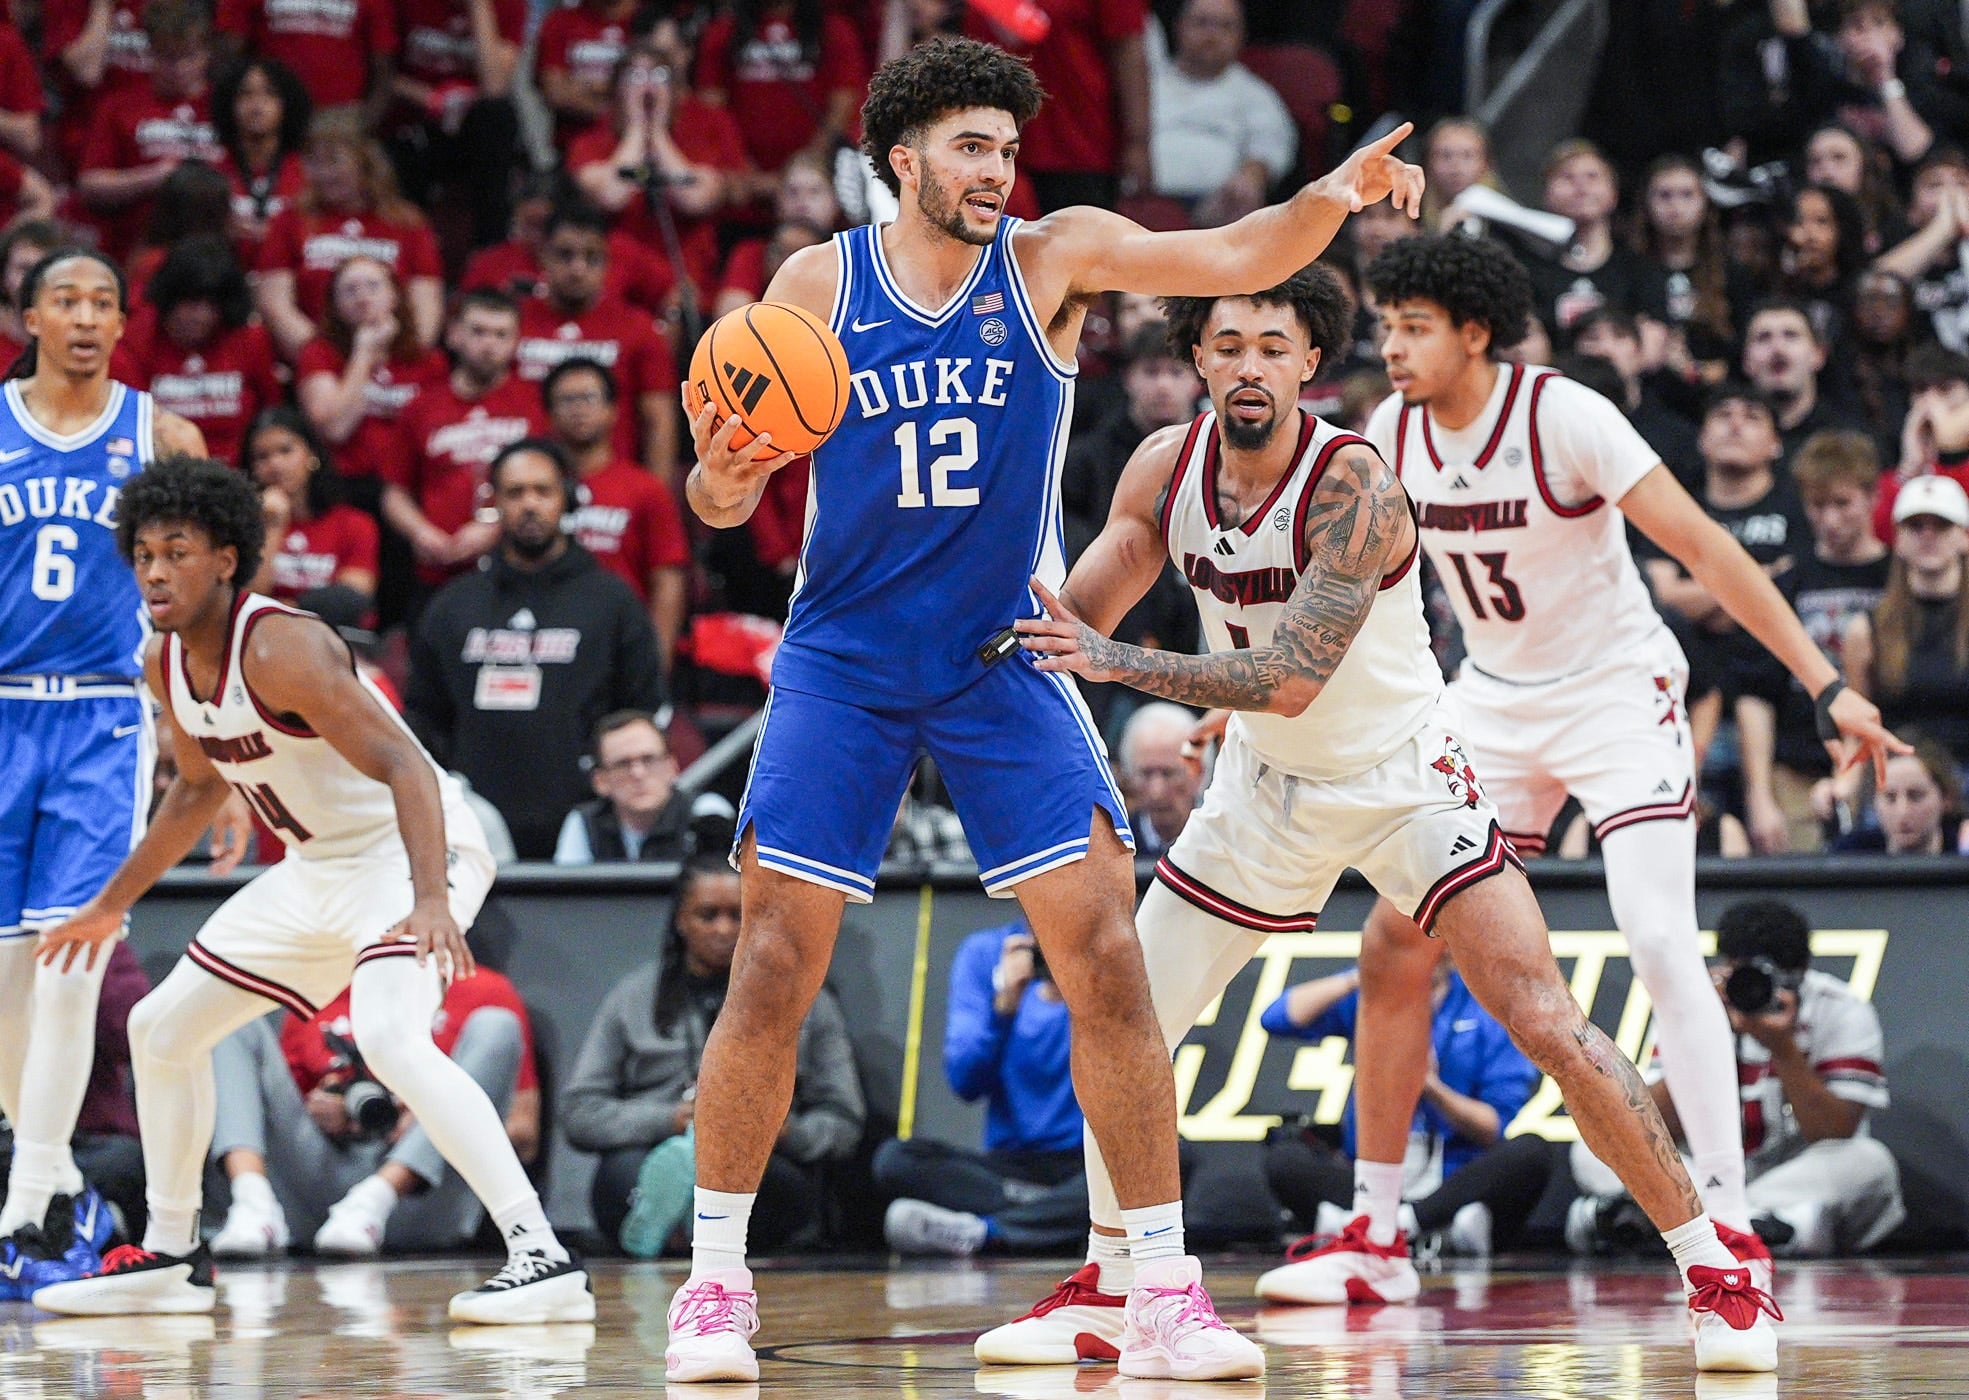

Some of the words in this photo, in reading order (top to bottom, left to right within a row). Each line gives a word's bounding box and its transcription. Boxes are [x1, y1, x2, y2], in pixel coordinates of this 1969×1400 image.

[850, 357, 1014, 419] DUKE
[893, 416, 980, 508] 12
[31, 523, 78, 602] 6
[1446, 552, 1526, 622] 13
